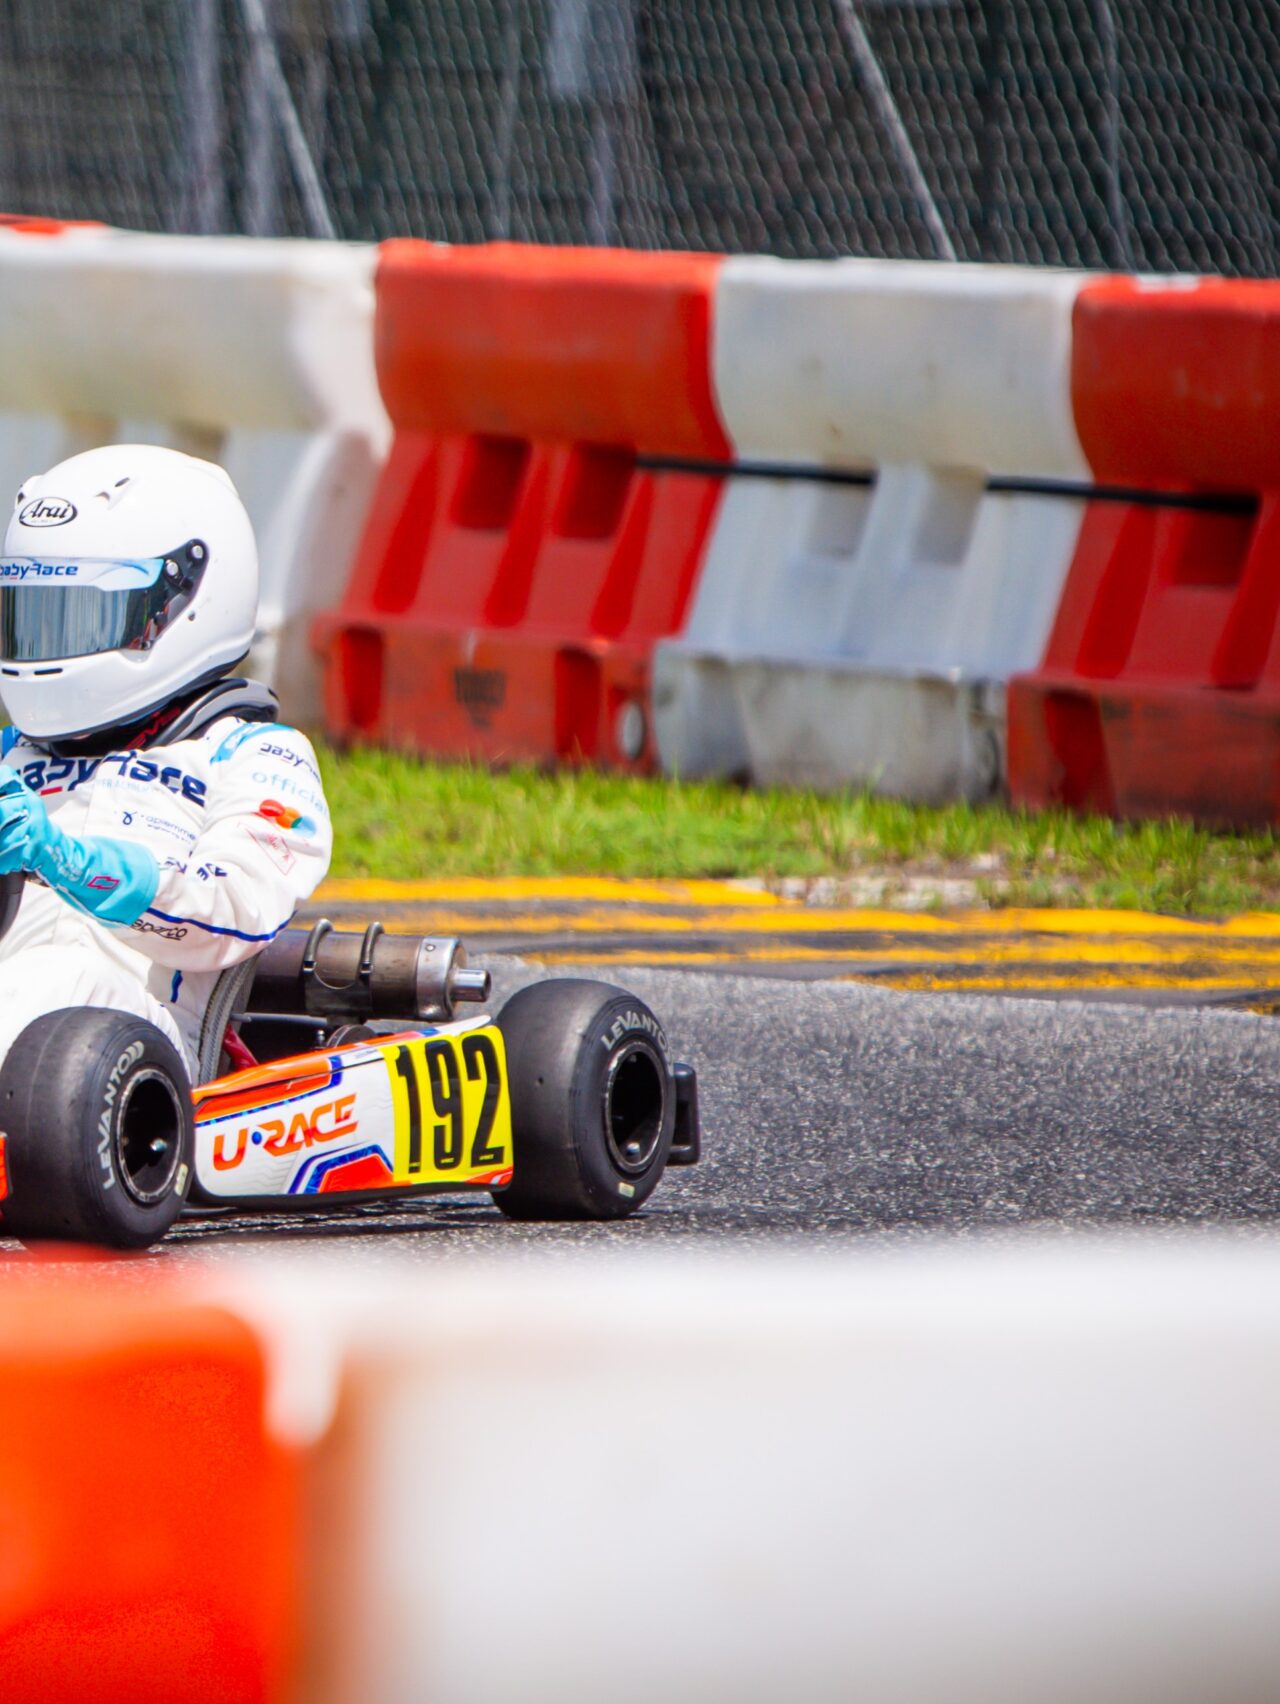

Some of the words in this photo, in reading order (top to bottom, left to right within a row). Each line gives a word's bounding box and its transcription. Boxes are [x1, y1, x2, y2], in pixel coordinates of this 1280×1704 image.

[20, 500, 70, 520] Arai
[17, 750, 207, 808] abyRace
[601, 1010, 669, 1053] LEVANTO
[97, 1052, 132, 1190] LEVANTO
[395, 1034, 505, 1174] 192
